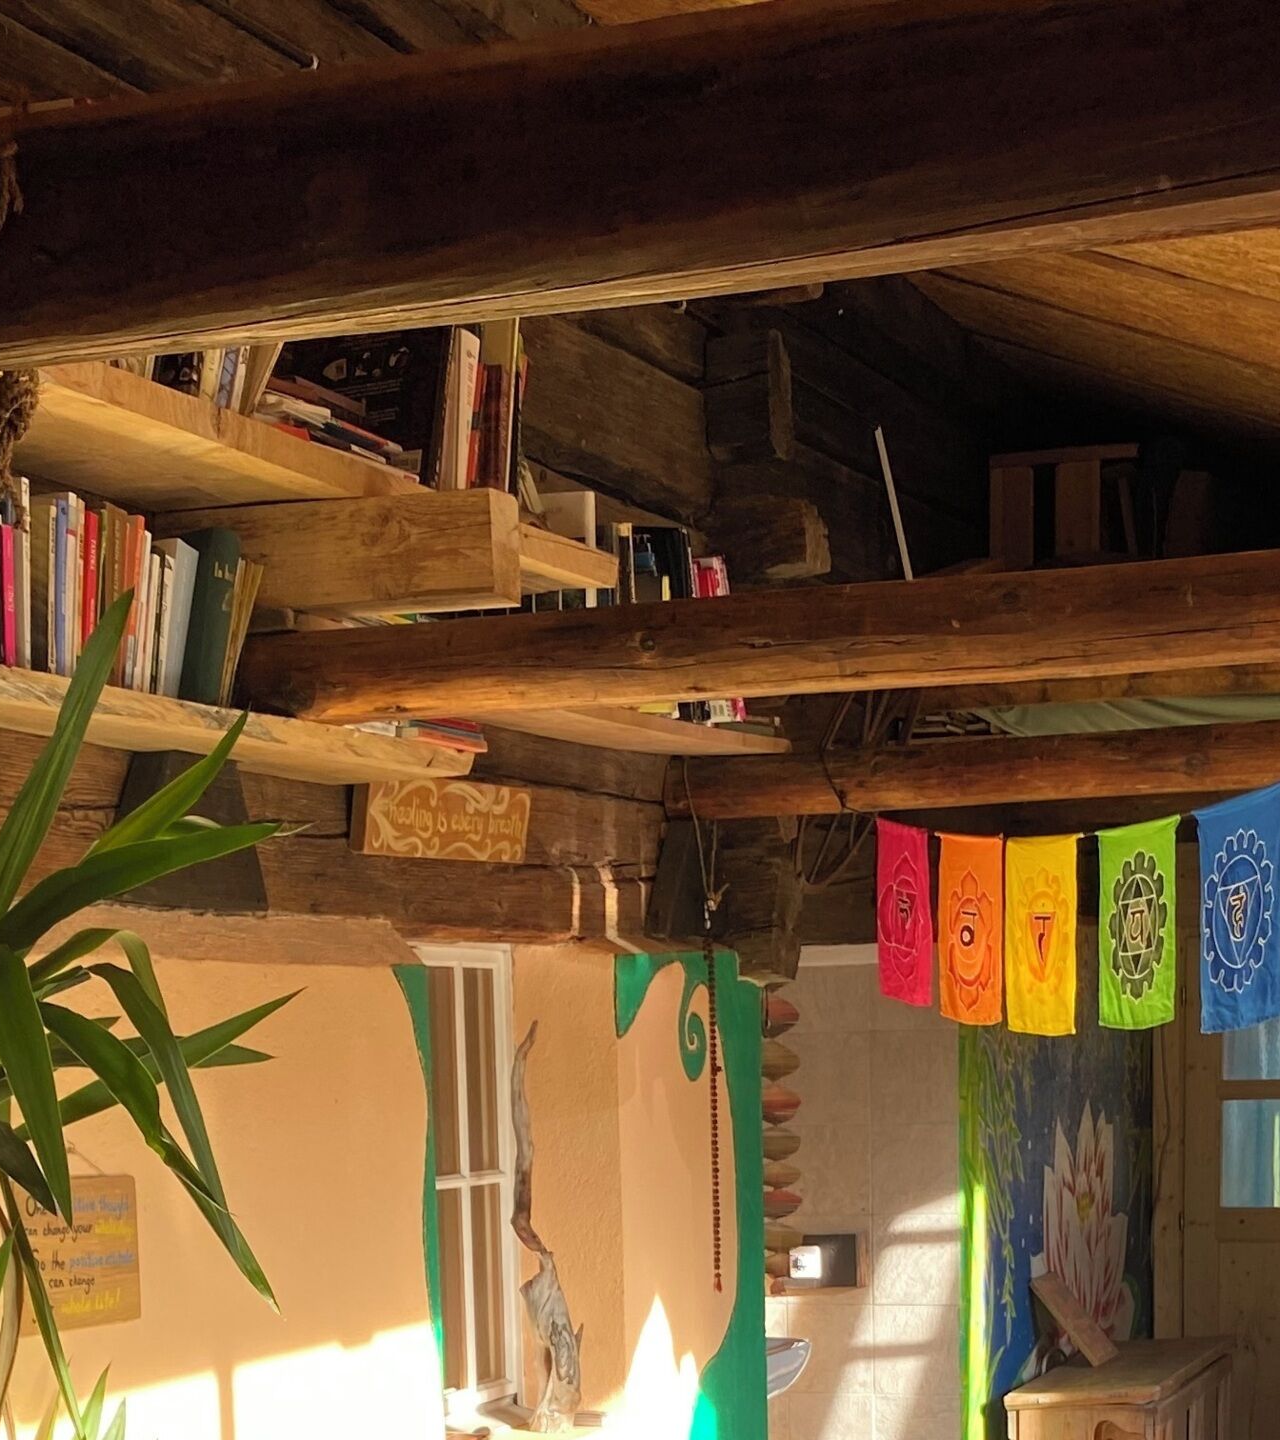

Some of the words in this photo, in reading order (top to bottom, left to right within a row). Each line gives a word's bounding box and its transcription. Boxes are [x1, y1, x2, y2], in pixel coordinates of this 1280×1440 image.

[389, 796, 432, 838] healing
[436, 808, 447, 833] is
[487, 809, 522, 839] breath
[43, 1223, 71, 1243] change
[71, 1223, 94, 1243] your
[52, 1248, 65, 1270] the
[48, 1278, 65, 1289] can
[69, 1274, 96, 1295] change
